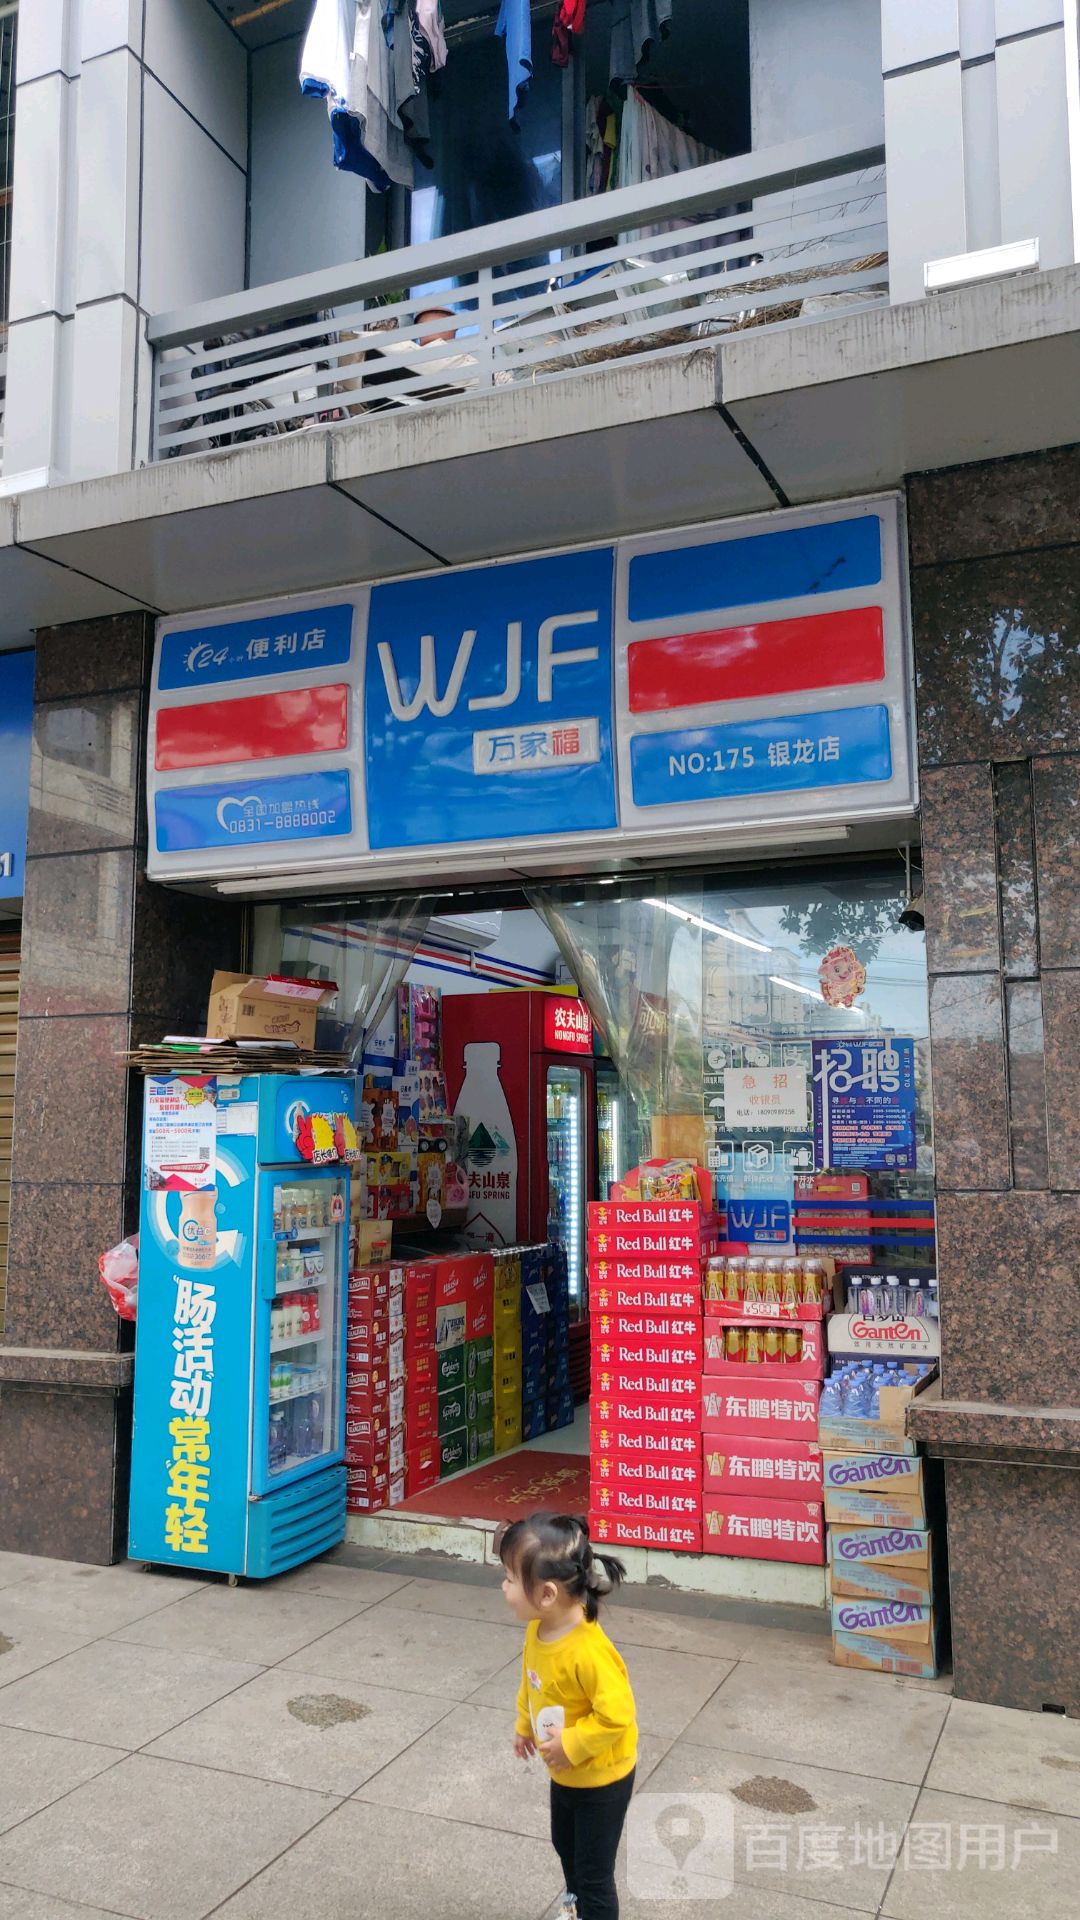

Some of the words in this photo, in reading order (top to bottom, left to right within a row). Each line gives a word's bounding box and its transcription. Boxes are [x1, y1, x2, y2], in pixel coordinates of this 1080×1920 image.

[246, 629, 327, 660] 便利店
[377, 609, 600, 722] WJF
[488, 727, 580, 764] 万家福
[669, 746, 755, 776] NO:175
[767, 736, 840, 768] 银龙店
[243, 798, 320, 817] 全国加盟热线
[229, 811, 336, 833] 0831-8888002
[555, 1007, 589, 1032] 农夫山泉
[554, 1029, 576, 1042] NONGFU
[812, 1048, 901, 1092] 招聘
[468, 1170, 511, 1189] 夫山泉
[483, 1190, 510, 1200] SPRING
[616, 1208, 641, 1222] Red
[643, 1208, 666, 1222] Bull
[668, 1208, 693, 1221] 红牛
[730, 1205, 786, 1229] WJF
[616, 1236, 640, 1249] Red
[643, 1236, 666, 1250] Bull
[668, 1236, 693, 1250] 红牛
[616, 1263, 640, 1277] Red
[643, 1264, 666, 1278] Bull
[668, 1264, 693, 1278] 红牛
[617, 1291, 641, 1305] Red
[644, 1292, 667, 1306] Bull
[669, 1292, 694, 1306] 红牛
[619, 1318, 642, 1332] Red
[645, 1319, 669, 1333] Bull
[671, 1320, 695, 1334] 红牛
[619, 1347, 642, 1361] Red
[646, 1348, 669, 1362] Bull
[671, 1349, 696, 1363] 红牛
[619, 1376, 643, 1390] Red
[646, 1377, 668, 1392] Bull
[671, 1378, 696, 1393] 红牛
[618, 1404, 642, 1418] Red
[645, 1406, 668, 1421] Bull
[670, 1408, 695, 1422] 红牛
[725, 1395, 816, 1423] 东鹏特饮
[618, 1433, 642, 1447] Red
[645, 1435, 668, 1450] Bull
[670, 1437, 695, 1451] 红牛
[618, 1462, 642, 1477] Red
[645, 1464, 668, 1479] Bull
[671, 1466, 695, 1481] 红牛
[728, 1455, 821, 1482] 东鹏特饮
[828, 1456, 912, 1485] Ganten
[618, 1492, 642, 1507] Red
[645, 1494, 669, 1509] Bull
[671, 1496, 696, 1511] 红牛
[617, 1523, 641, 1538] Red
[644, 1525, 667, 1541] Bull
[669, 1528, 694, 1543] 红牛
[727, 1514, 819, 1543] 东鹏特饮
[838, 1529, 923, 1560] Ganten
[838, 1601, 923, 1630] Ganten
